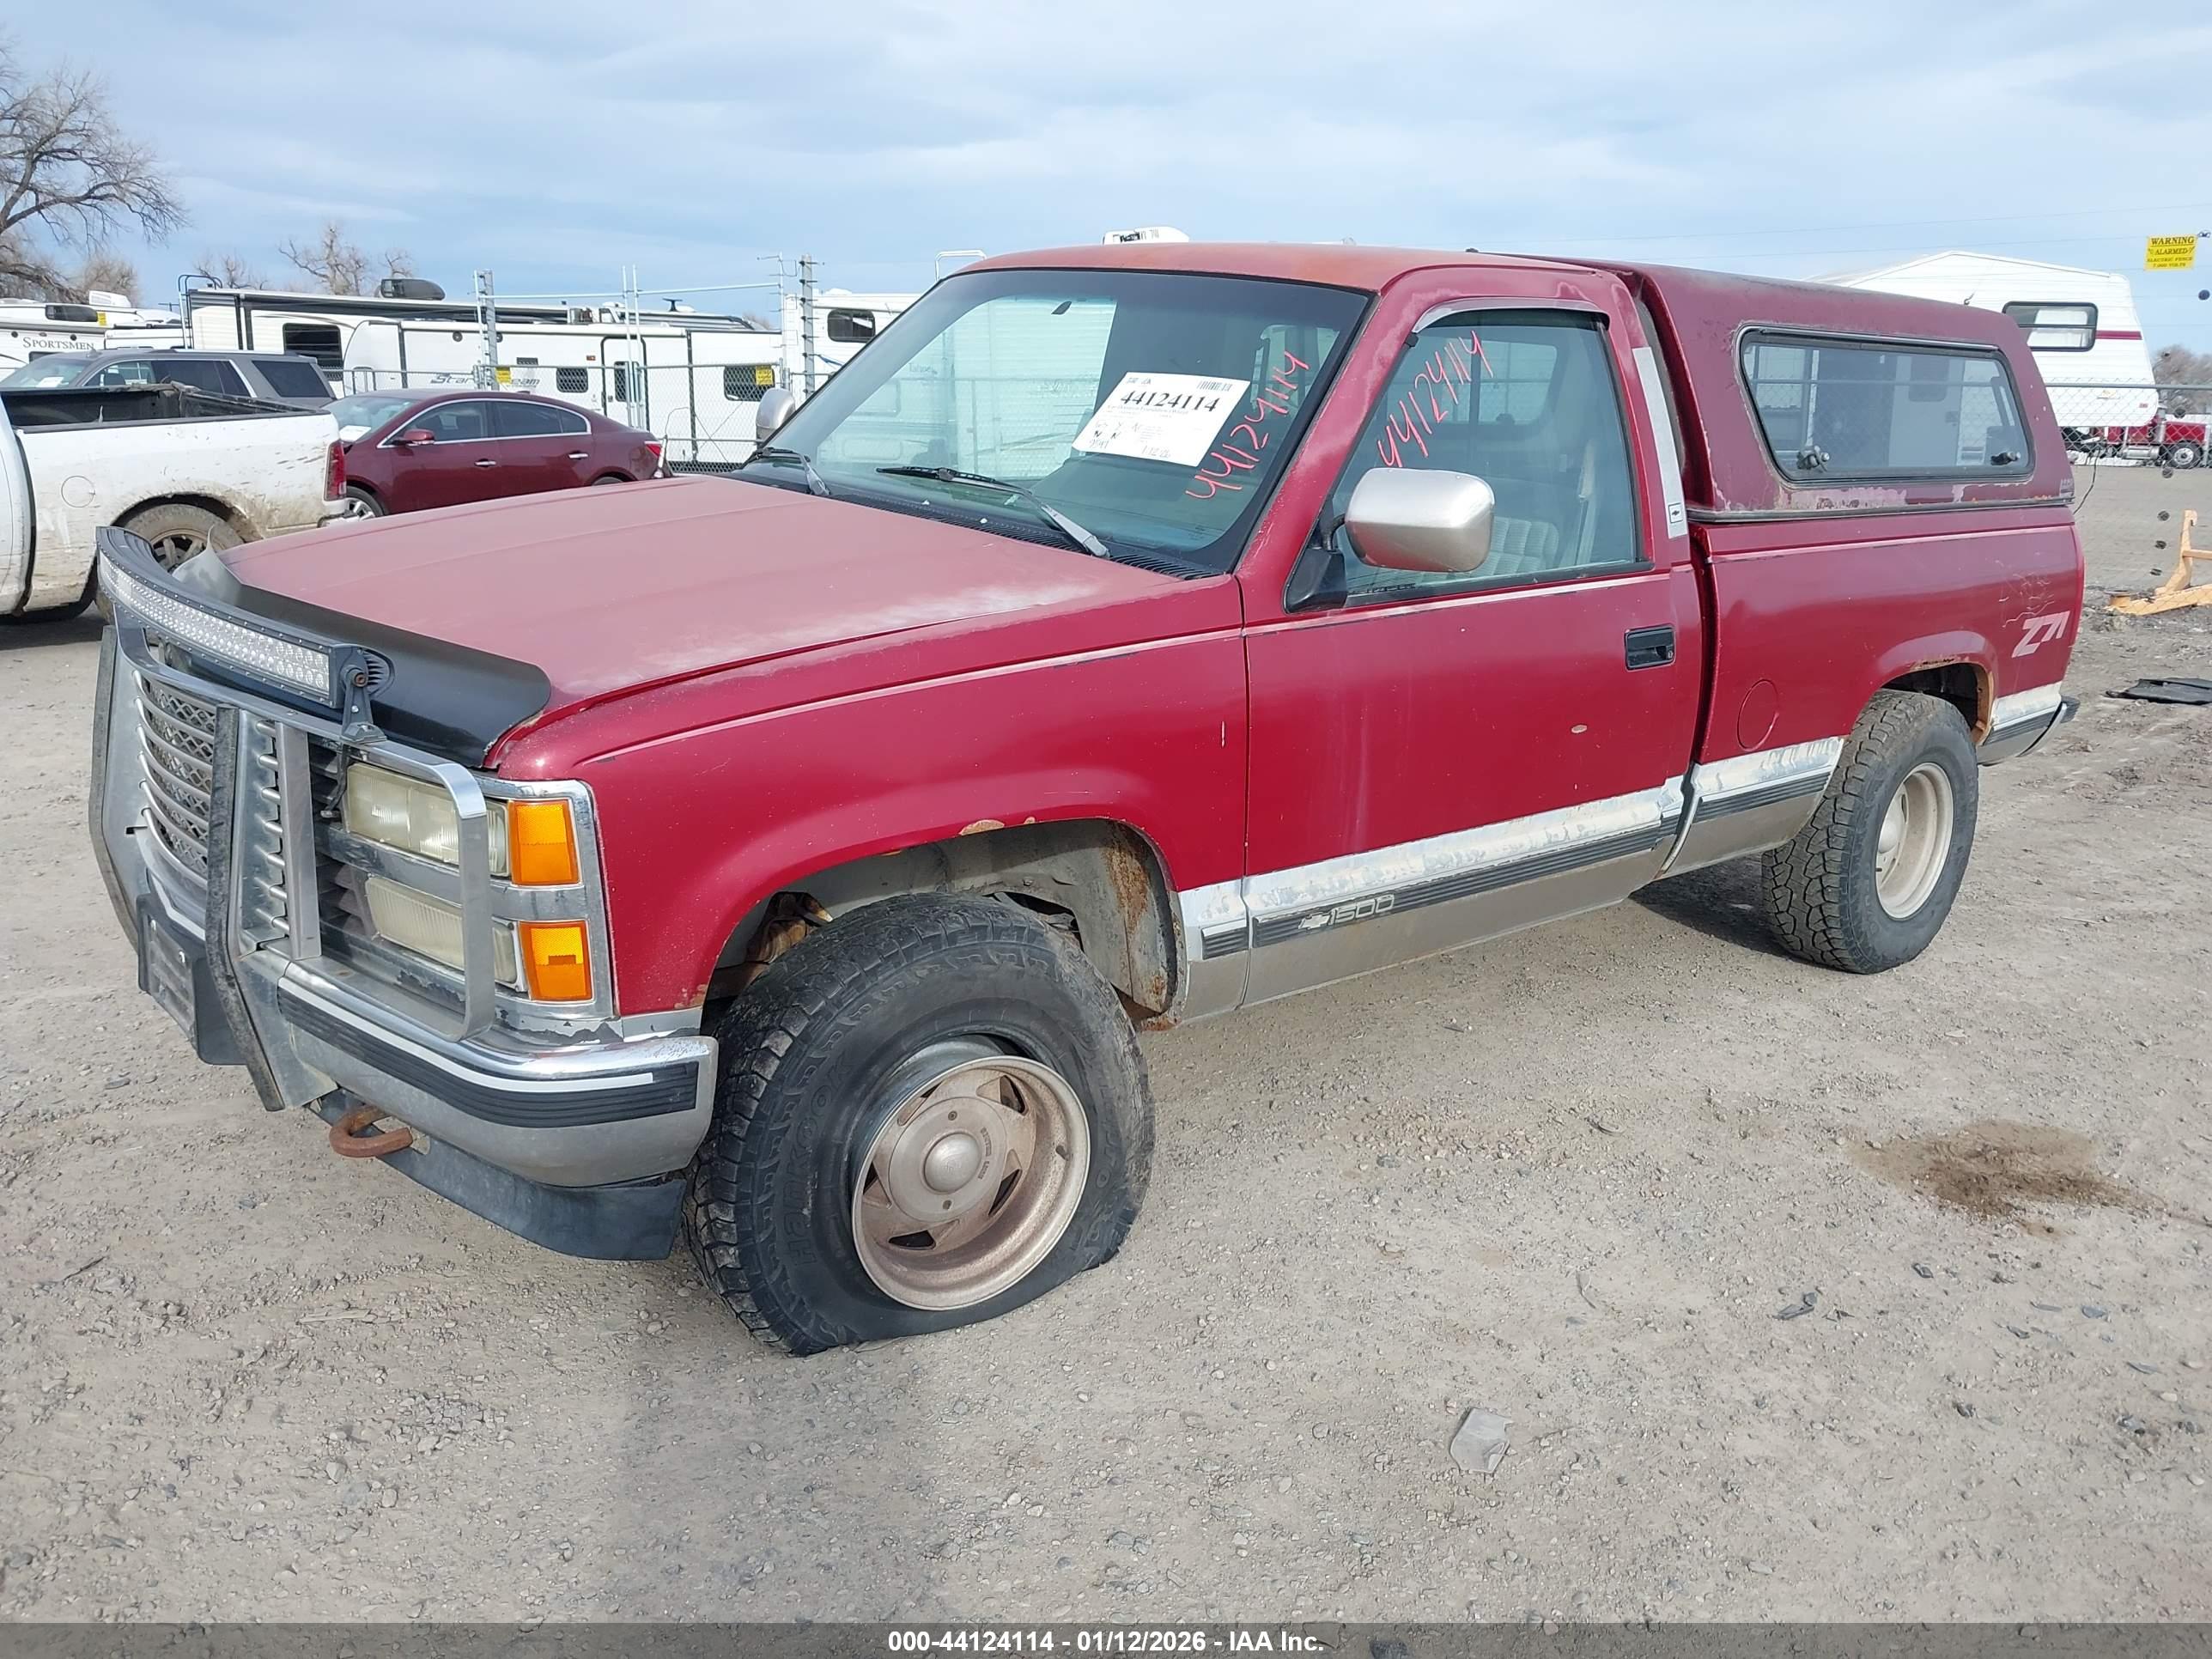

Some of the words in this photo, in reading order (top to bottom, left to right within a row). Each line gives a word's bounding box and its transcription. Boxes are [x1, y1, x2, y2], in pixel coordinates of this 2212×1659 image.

[2150, 236, 2195, 246] WARNING
[22, 337, 94, 351] SPORTSMEN
[1121, 390, 1220, 412] 44124114
[1376, 330, 1494, 468] 44124114
[1185, 350, 1310, 499] 44124114
[2011, 611, 2070, 659] Z71
[1328, 894, 1395, 925] 1500
